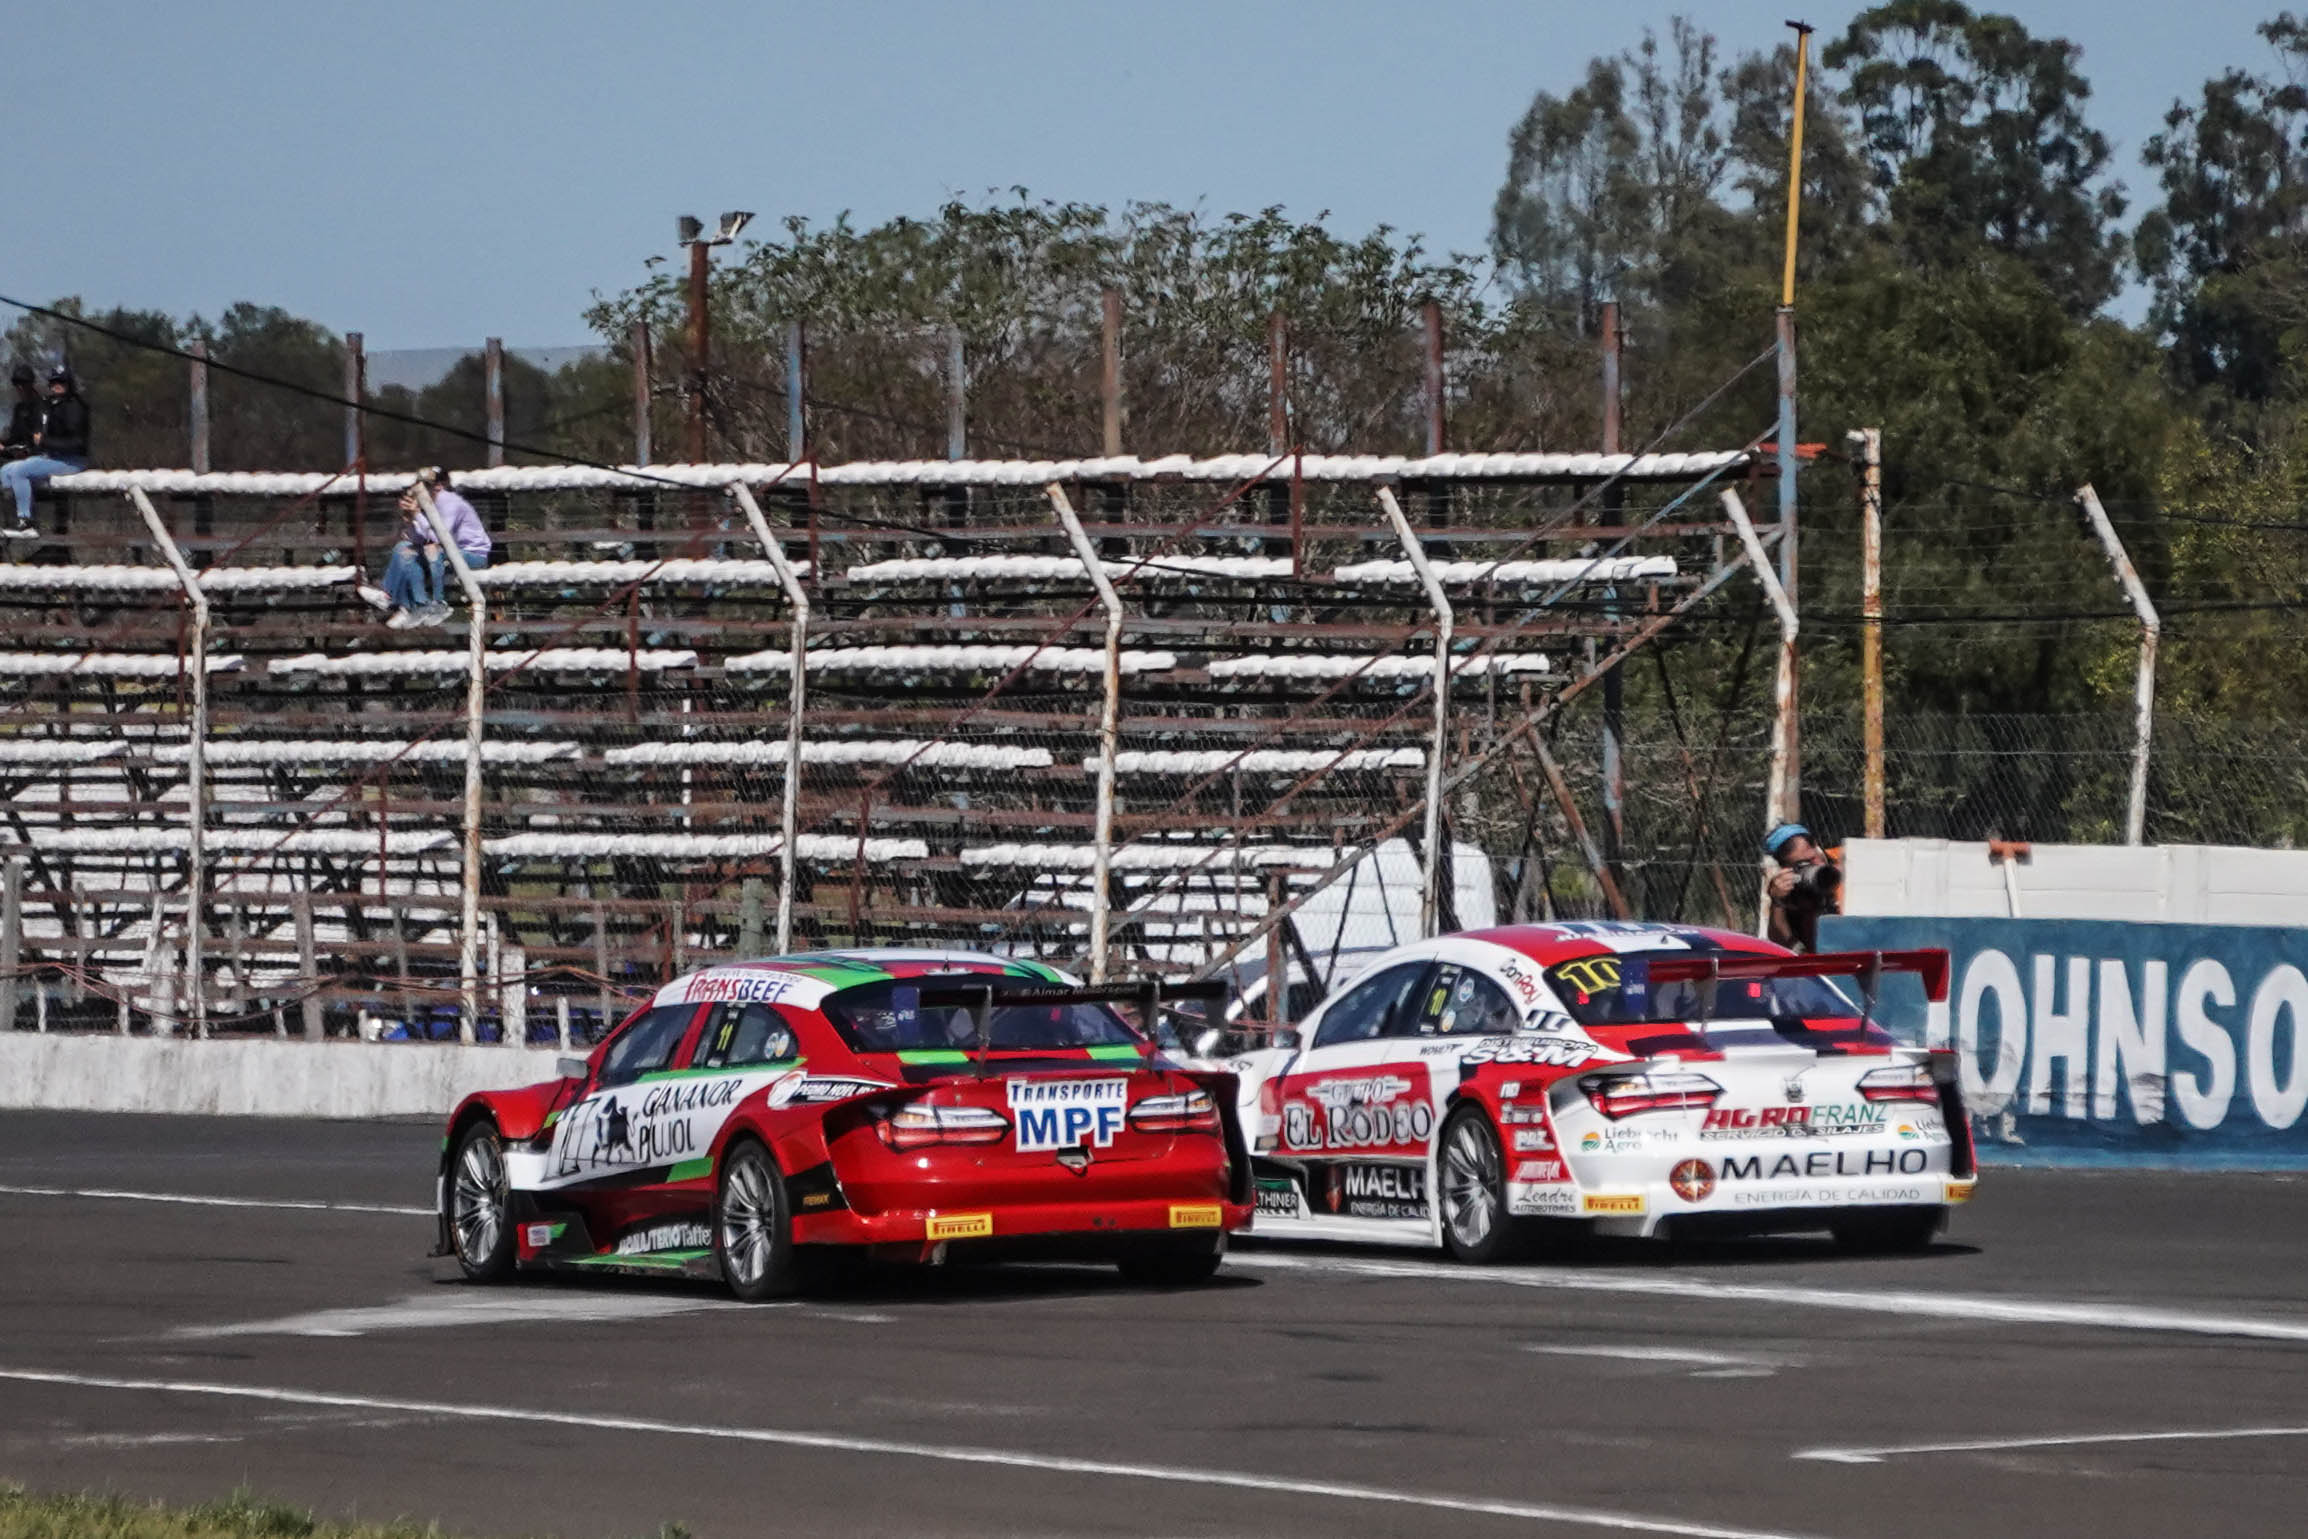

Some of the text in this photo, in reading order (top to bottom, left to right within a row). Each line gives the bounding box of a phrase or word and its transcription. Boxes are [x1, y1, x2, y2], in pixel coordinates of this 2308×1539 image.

[684, 973, 793, 1003] TRANSBEEF
[716, 1023, 734, 1051] 11
[1012, 1083, 1123, 1102] TRANSPORTE
[1019, 1107, 1120, 1145] MPF
[1285, 1103, 1433, 1148] EL RODEO
[639, 1117, 696, 1164] PUJOL
[1720, 1148, 1928, 1180] MAELHO
[1587, 1196, 1641, 1210] PIRELLI
[1818, 1188, 1842, 1201] DE
[1847, 1186, 1921, 1201] CALIDAD
[933, 1218, 986, 1235] PIRELLI
[1176, 1210, 1217, 1224] PIRELLI
